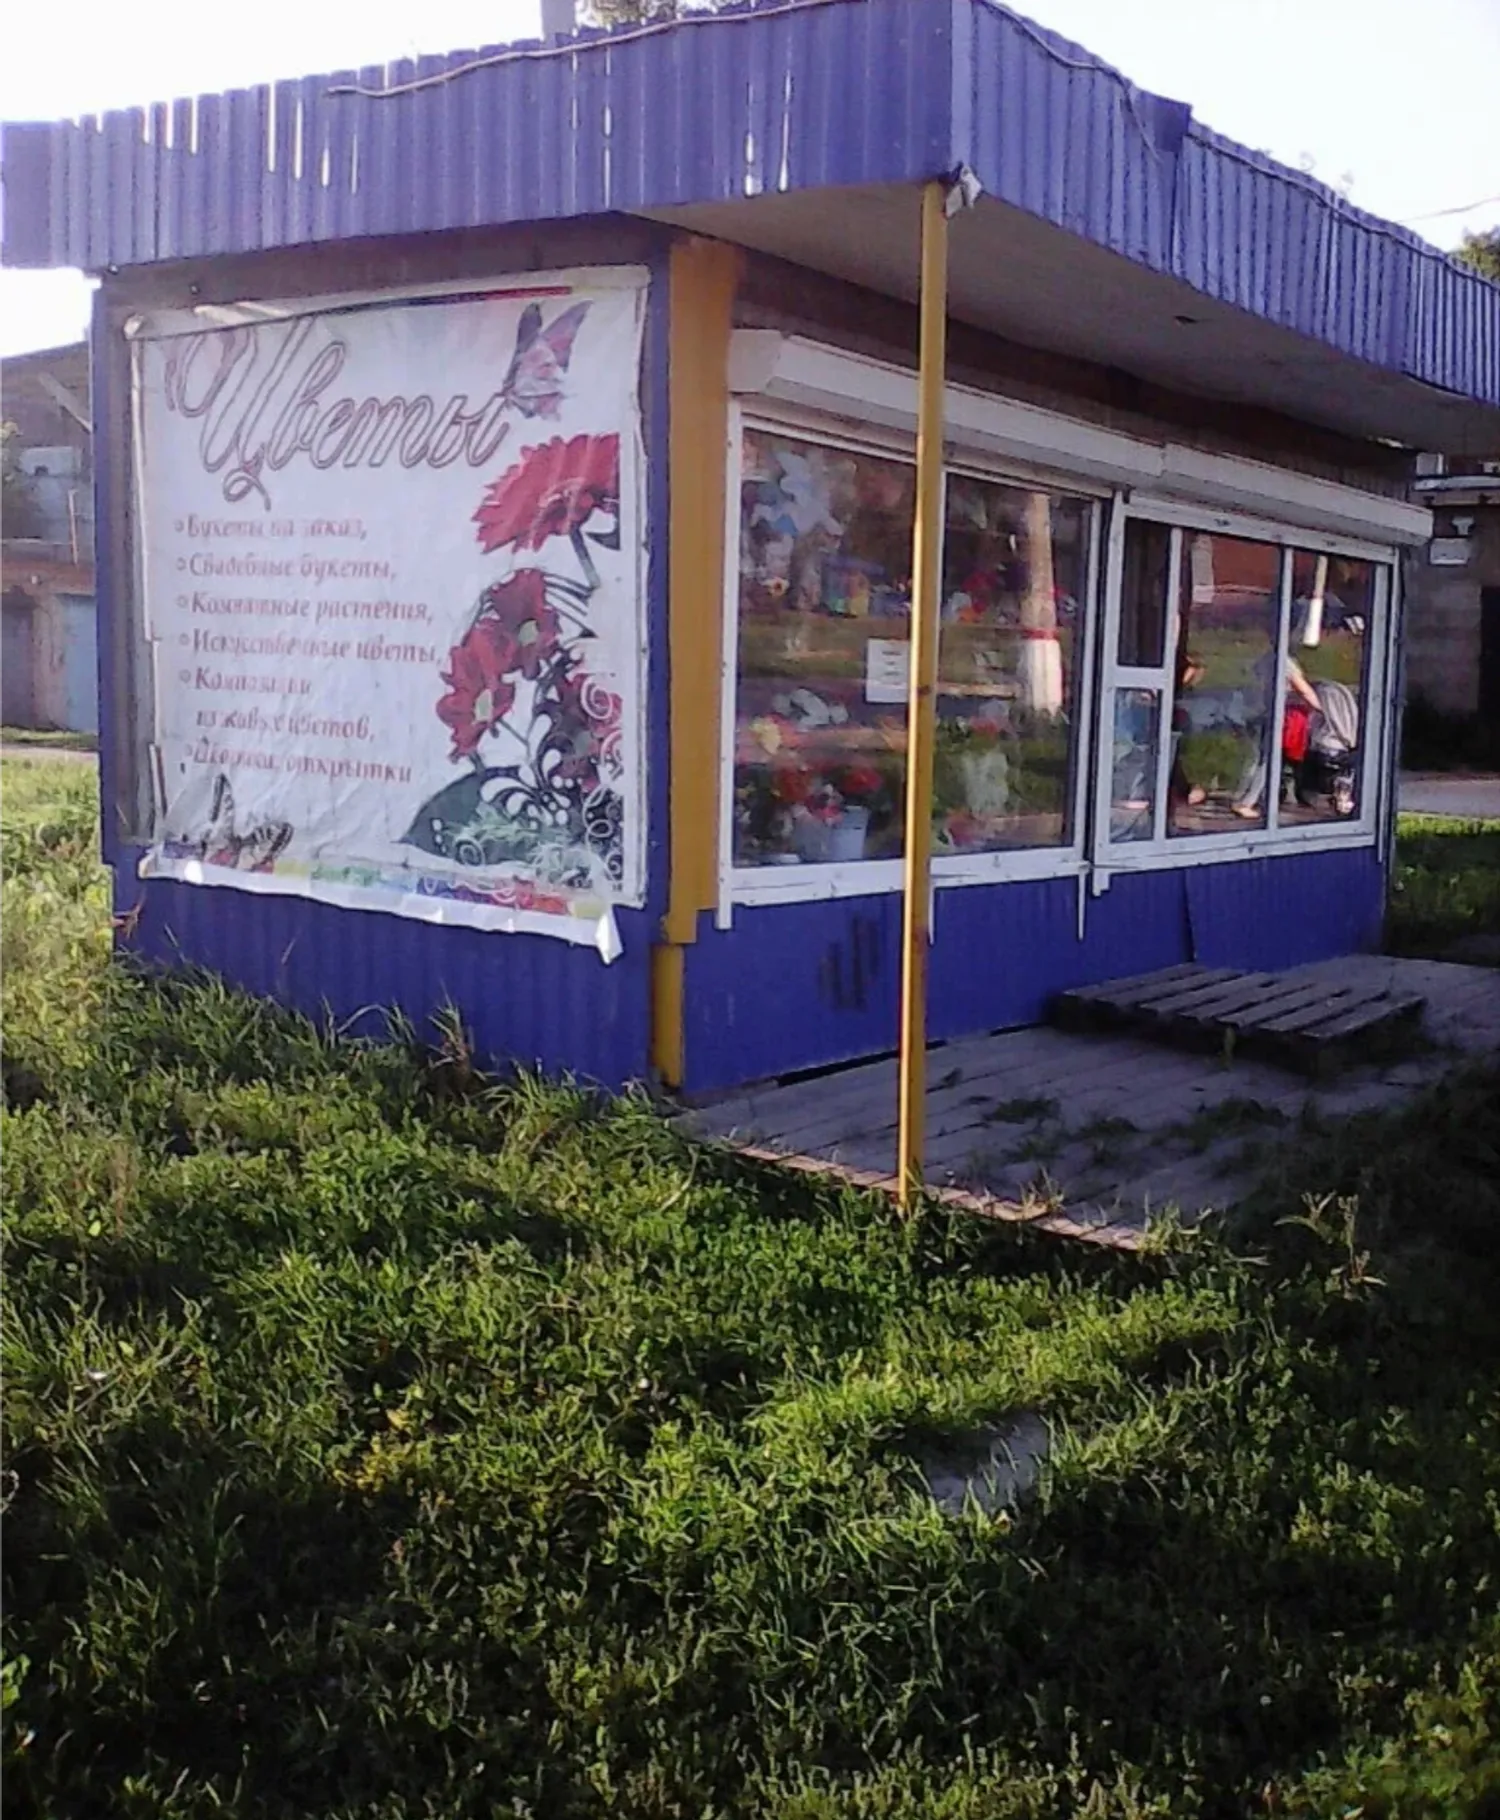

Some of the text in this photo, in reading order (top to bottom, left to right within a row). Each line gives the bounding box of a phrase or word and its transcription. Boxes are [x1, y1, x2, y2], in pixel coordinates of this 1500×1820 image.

[165, 316, 510, 511] Цветы
[301, 518, 368, 541] аказ,
[189, 553, 397, 585] Свадебные букеты,
[191, 591, 433, 625] Комнатные растения,
[355, 634, 442, 665] цветы,
[195, 666, 312, 695] Композиии
[285, 754, 412, 785] открытки
